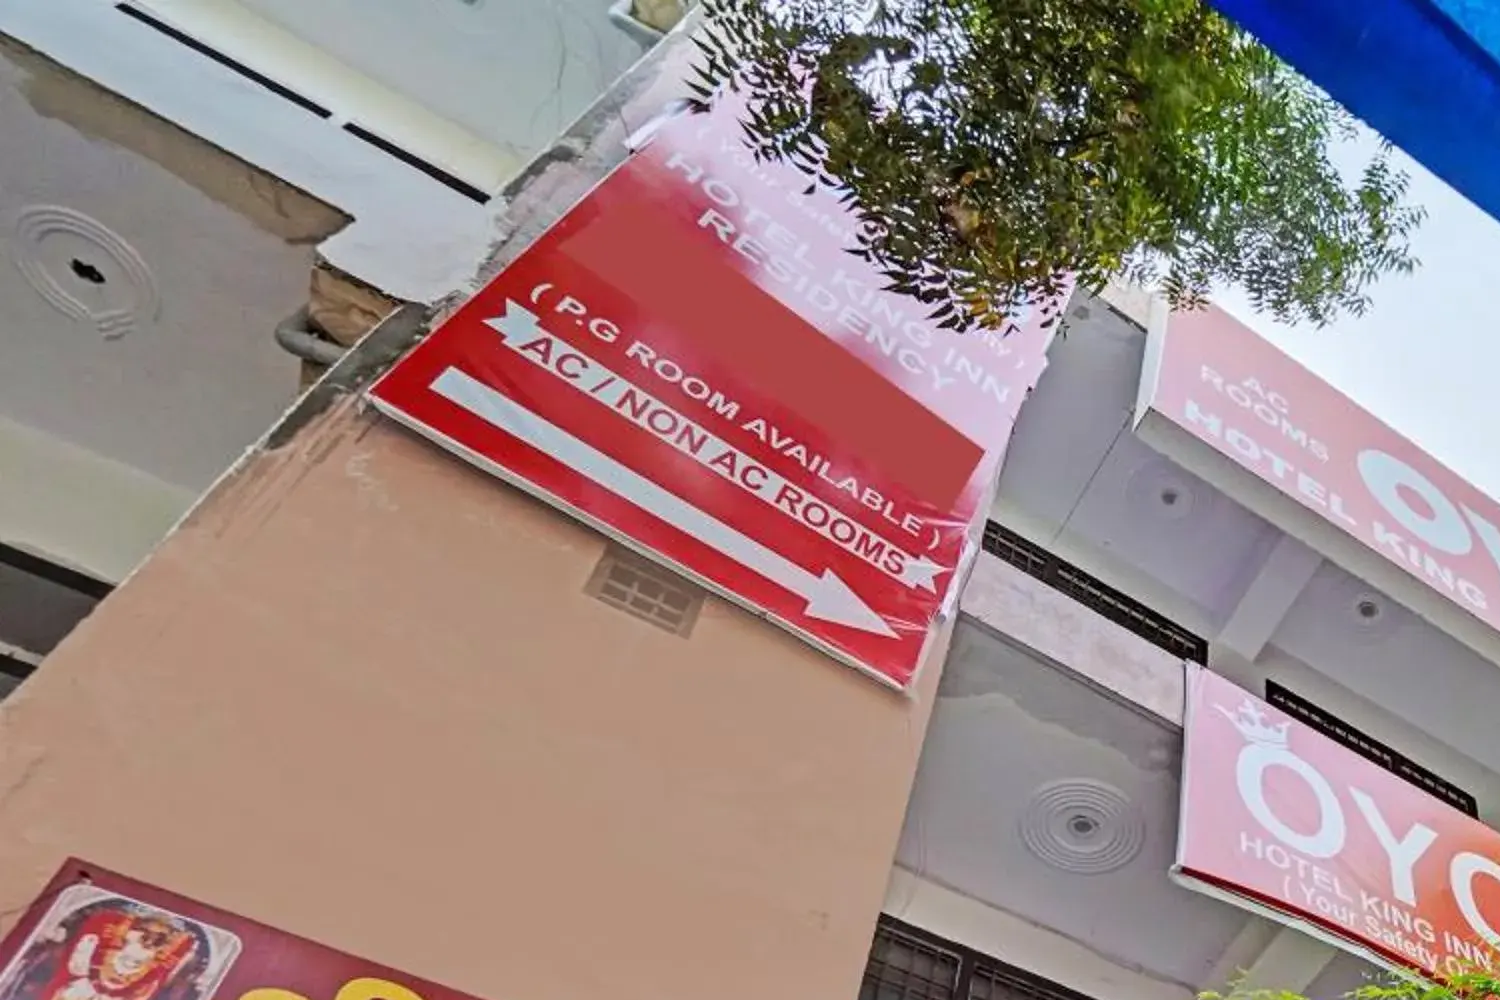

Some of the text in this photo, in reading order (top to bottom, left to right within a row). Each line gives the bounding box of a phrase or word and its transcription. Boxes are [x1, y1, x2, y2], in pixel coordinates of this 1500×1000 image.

[665, 151, 1011, 405] HOTEL KING INN
[697, 209, 957, 391] RESIDENCY
[625, 339, 741, 421] ROOM
[1241, 375, 1289, 415] AC
[519, 335, 586, 383] AC
[615, 385, 710, 456] NON
[709, 449, 766, 494] AC
[774, 485, 909, 576] ROOMS
[1183, 400, 1359, 528] HOTEL
[1372, 522, 1489, 608] KING
[1239, 832, 1355, 904] HOTEL
[1358, 888, 1436, 945] KING
[1299, 884, 1359, 928] Your
[1365, 908, 1438, 970] Safety
